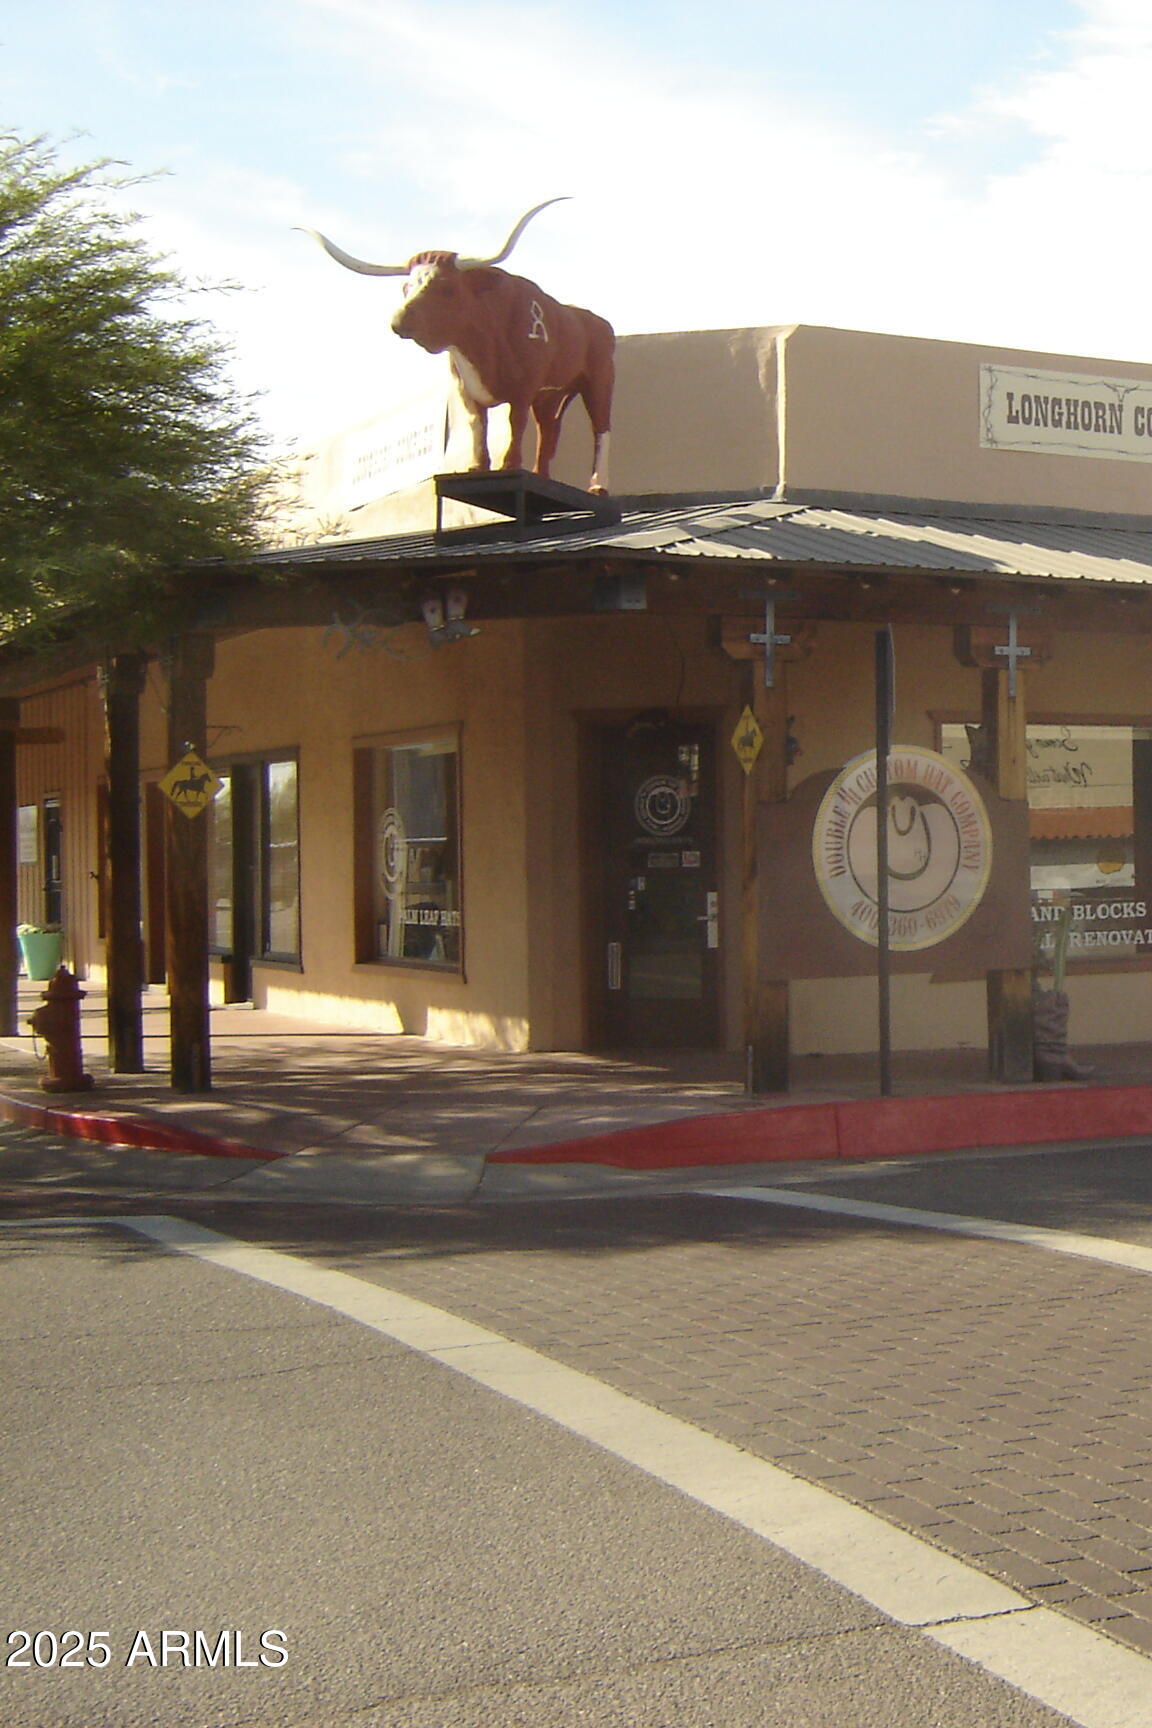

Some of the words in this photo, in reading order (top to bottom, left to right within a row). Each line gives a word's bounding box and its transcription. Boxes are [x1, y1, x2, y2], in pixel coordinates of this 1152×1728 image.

[1006, 392, 1123, 435] LONGHORN
[824, 805, 851, 879] DOUBLE
[856, 758, 919, 792] CUTOM
[923, 764, 954, 793] HAT
[951, 791, 981, 870] COMPANY
[1072, 902, 1147, 920] BLOCKS
